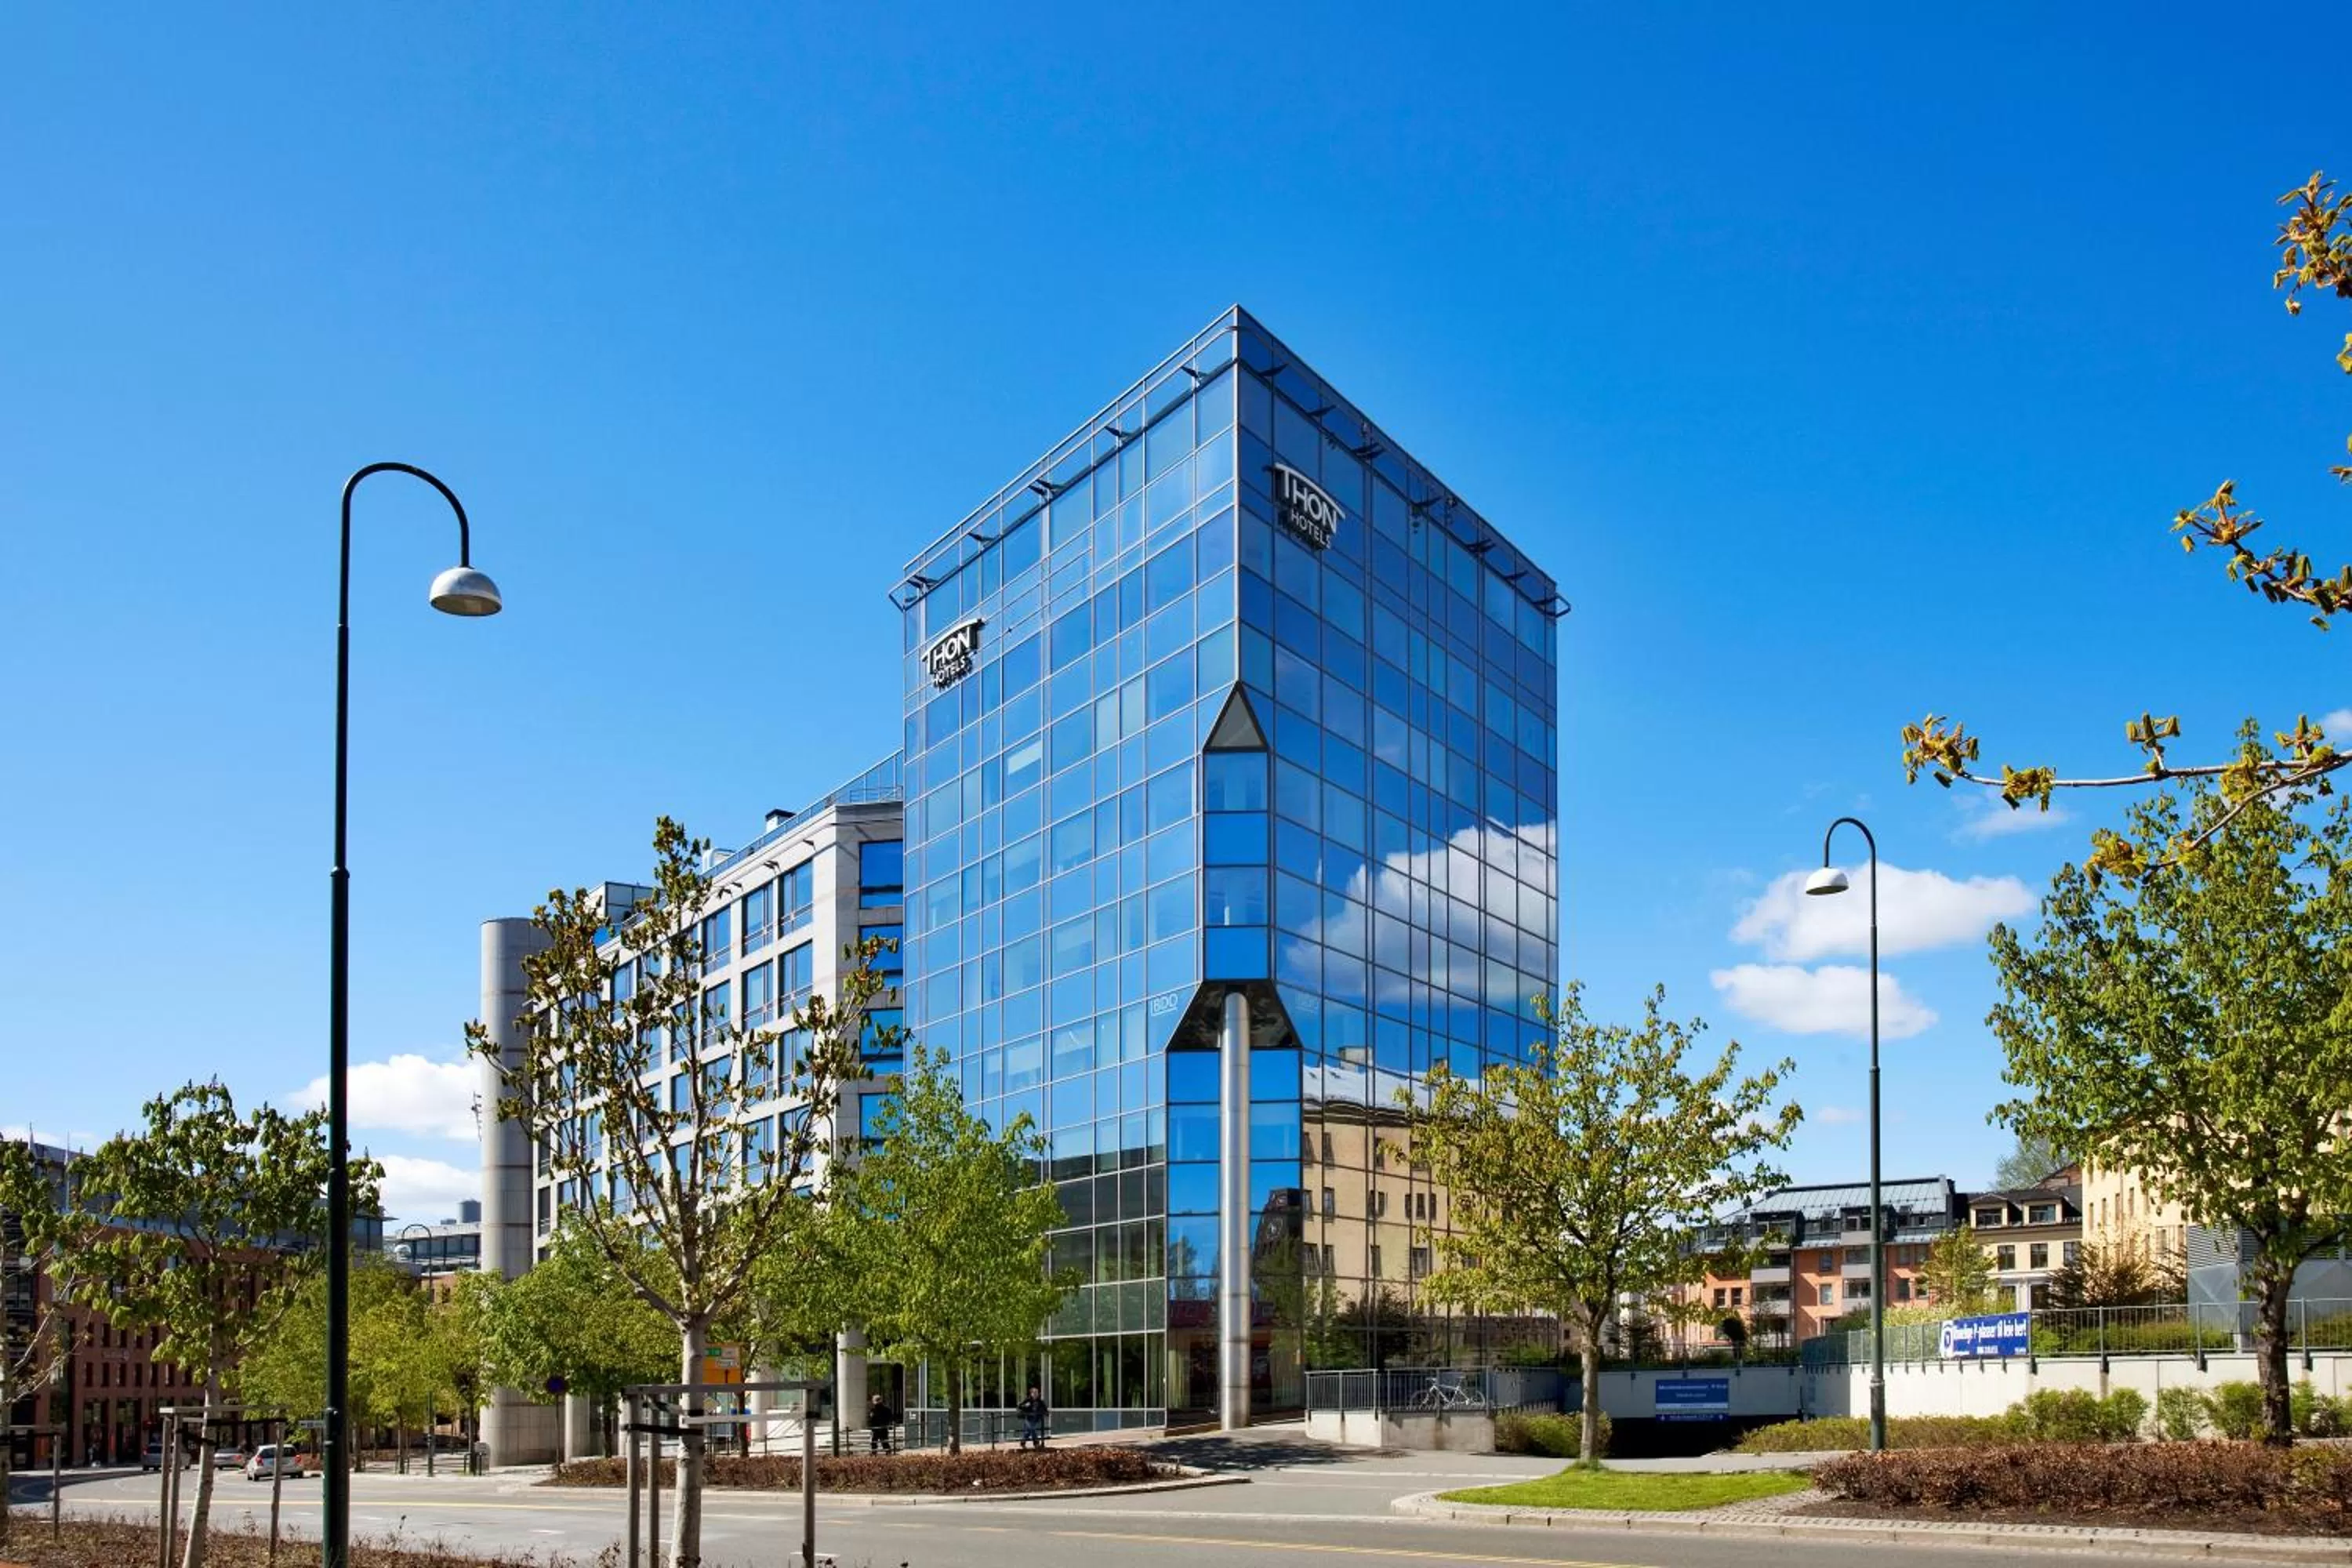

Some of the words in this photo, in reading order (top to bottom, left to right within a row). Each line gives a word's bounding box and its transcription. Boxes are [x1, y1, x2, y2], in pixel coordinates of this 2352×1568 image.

[1274, 463, 1346, 534] THON
[1291, 508, 1331, 549] HOTELS
[920, 618, 979, 674] THON
[932, 655, 965, 684] HOTELS
